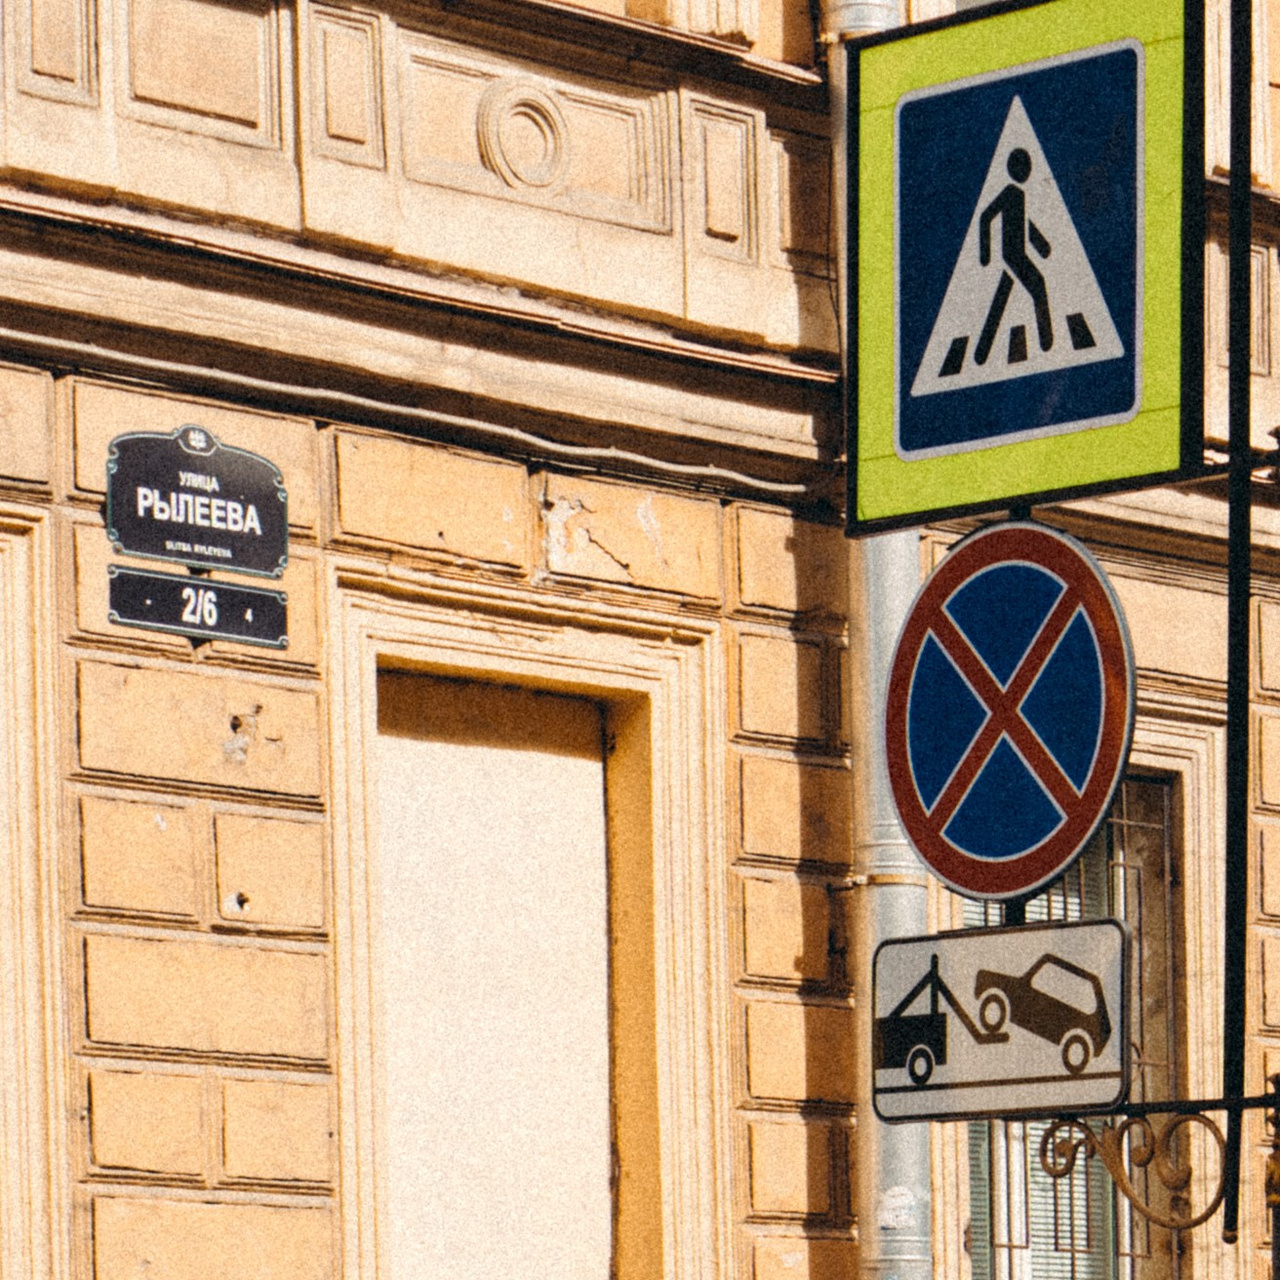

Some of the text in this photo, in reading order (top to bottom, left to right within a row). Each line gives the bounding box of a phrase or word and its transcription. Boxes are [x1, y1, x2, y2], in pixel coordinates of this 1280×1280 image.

[178, 471, 220, 493] УЛИЦА
[136, 486, 263, 536] РЫЛЕЕВА
[181, 587, 218, 626] 2/6
